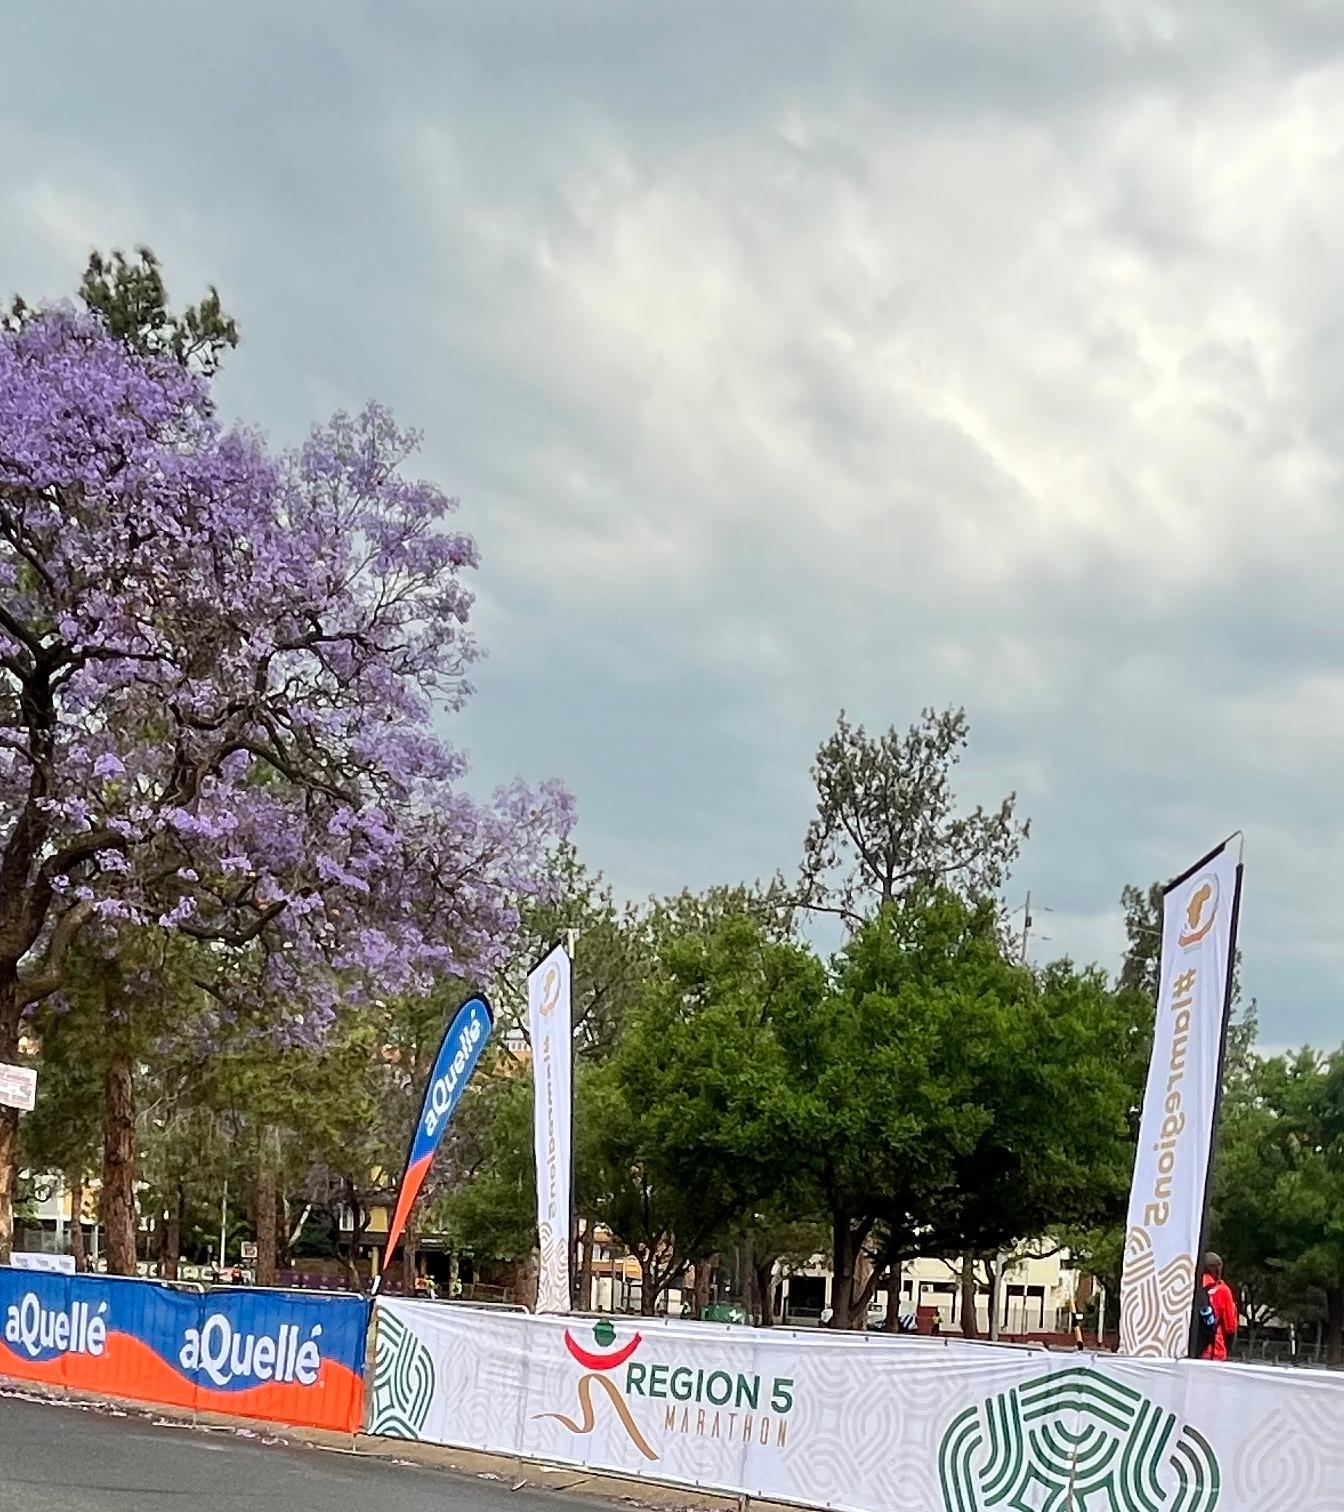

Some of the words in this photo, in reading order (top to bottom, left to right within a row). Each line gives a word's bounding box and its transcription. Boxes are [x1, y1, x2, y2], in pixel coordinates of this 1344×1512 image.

[424, 1009, 481, 1137] aQuellé
[5, 1292, 108, 1357] aQuellé
[179, 1313, 323, 1386] aQuellé
[626, 1362, 760, 1411] REGION
[771, 1378, 794, 1414] 5
[664, 1405, 788, 1448] MARATHON
